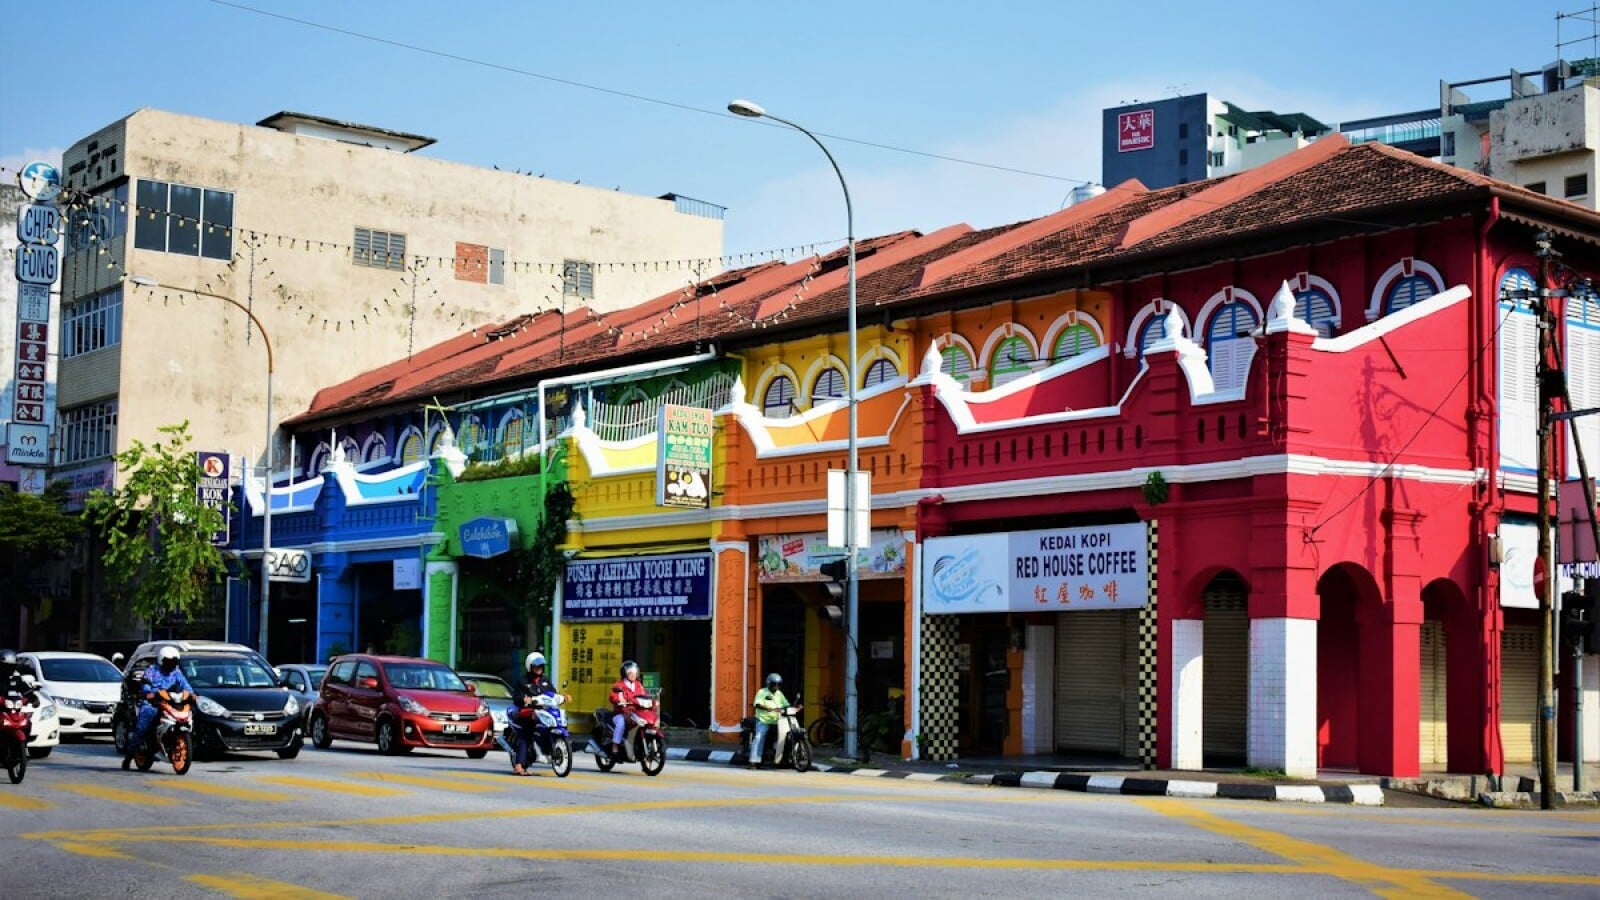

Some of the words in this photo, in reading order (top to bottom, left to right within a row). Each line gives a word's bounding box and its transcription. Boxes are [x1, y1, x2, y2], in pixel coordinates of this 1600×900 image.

[1122, 114, 1152, 132] 大華
[24, 208, 53, 238] CHIP
[21, 248, 54, 279] FONG
[668, 419, 689, 432] KAM
[203, 488, 223, 500] KOK
[1040, 534, 1076, 551] KEDAI
[1081, 532, 1111, 549] KOPI
[566, 564, 598, 583] PUSAT
[598, 561, 641, 582] JAHITAN
[644, 559, 673, 579] YOOH
[676, 558, 706, 577] MING
[1016, 556, 1039, 579] RED
[1043, 553, 1084, 577] HOUSE
[1088, 550, 1137, 575] COFFEE
[1034, 579, 1119, 604] 紅屋咖啡
